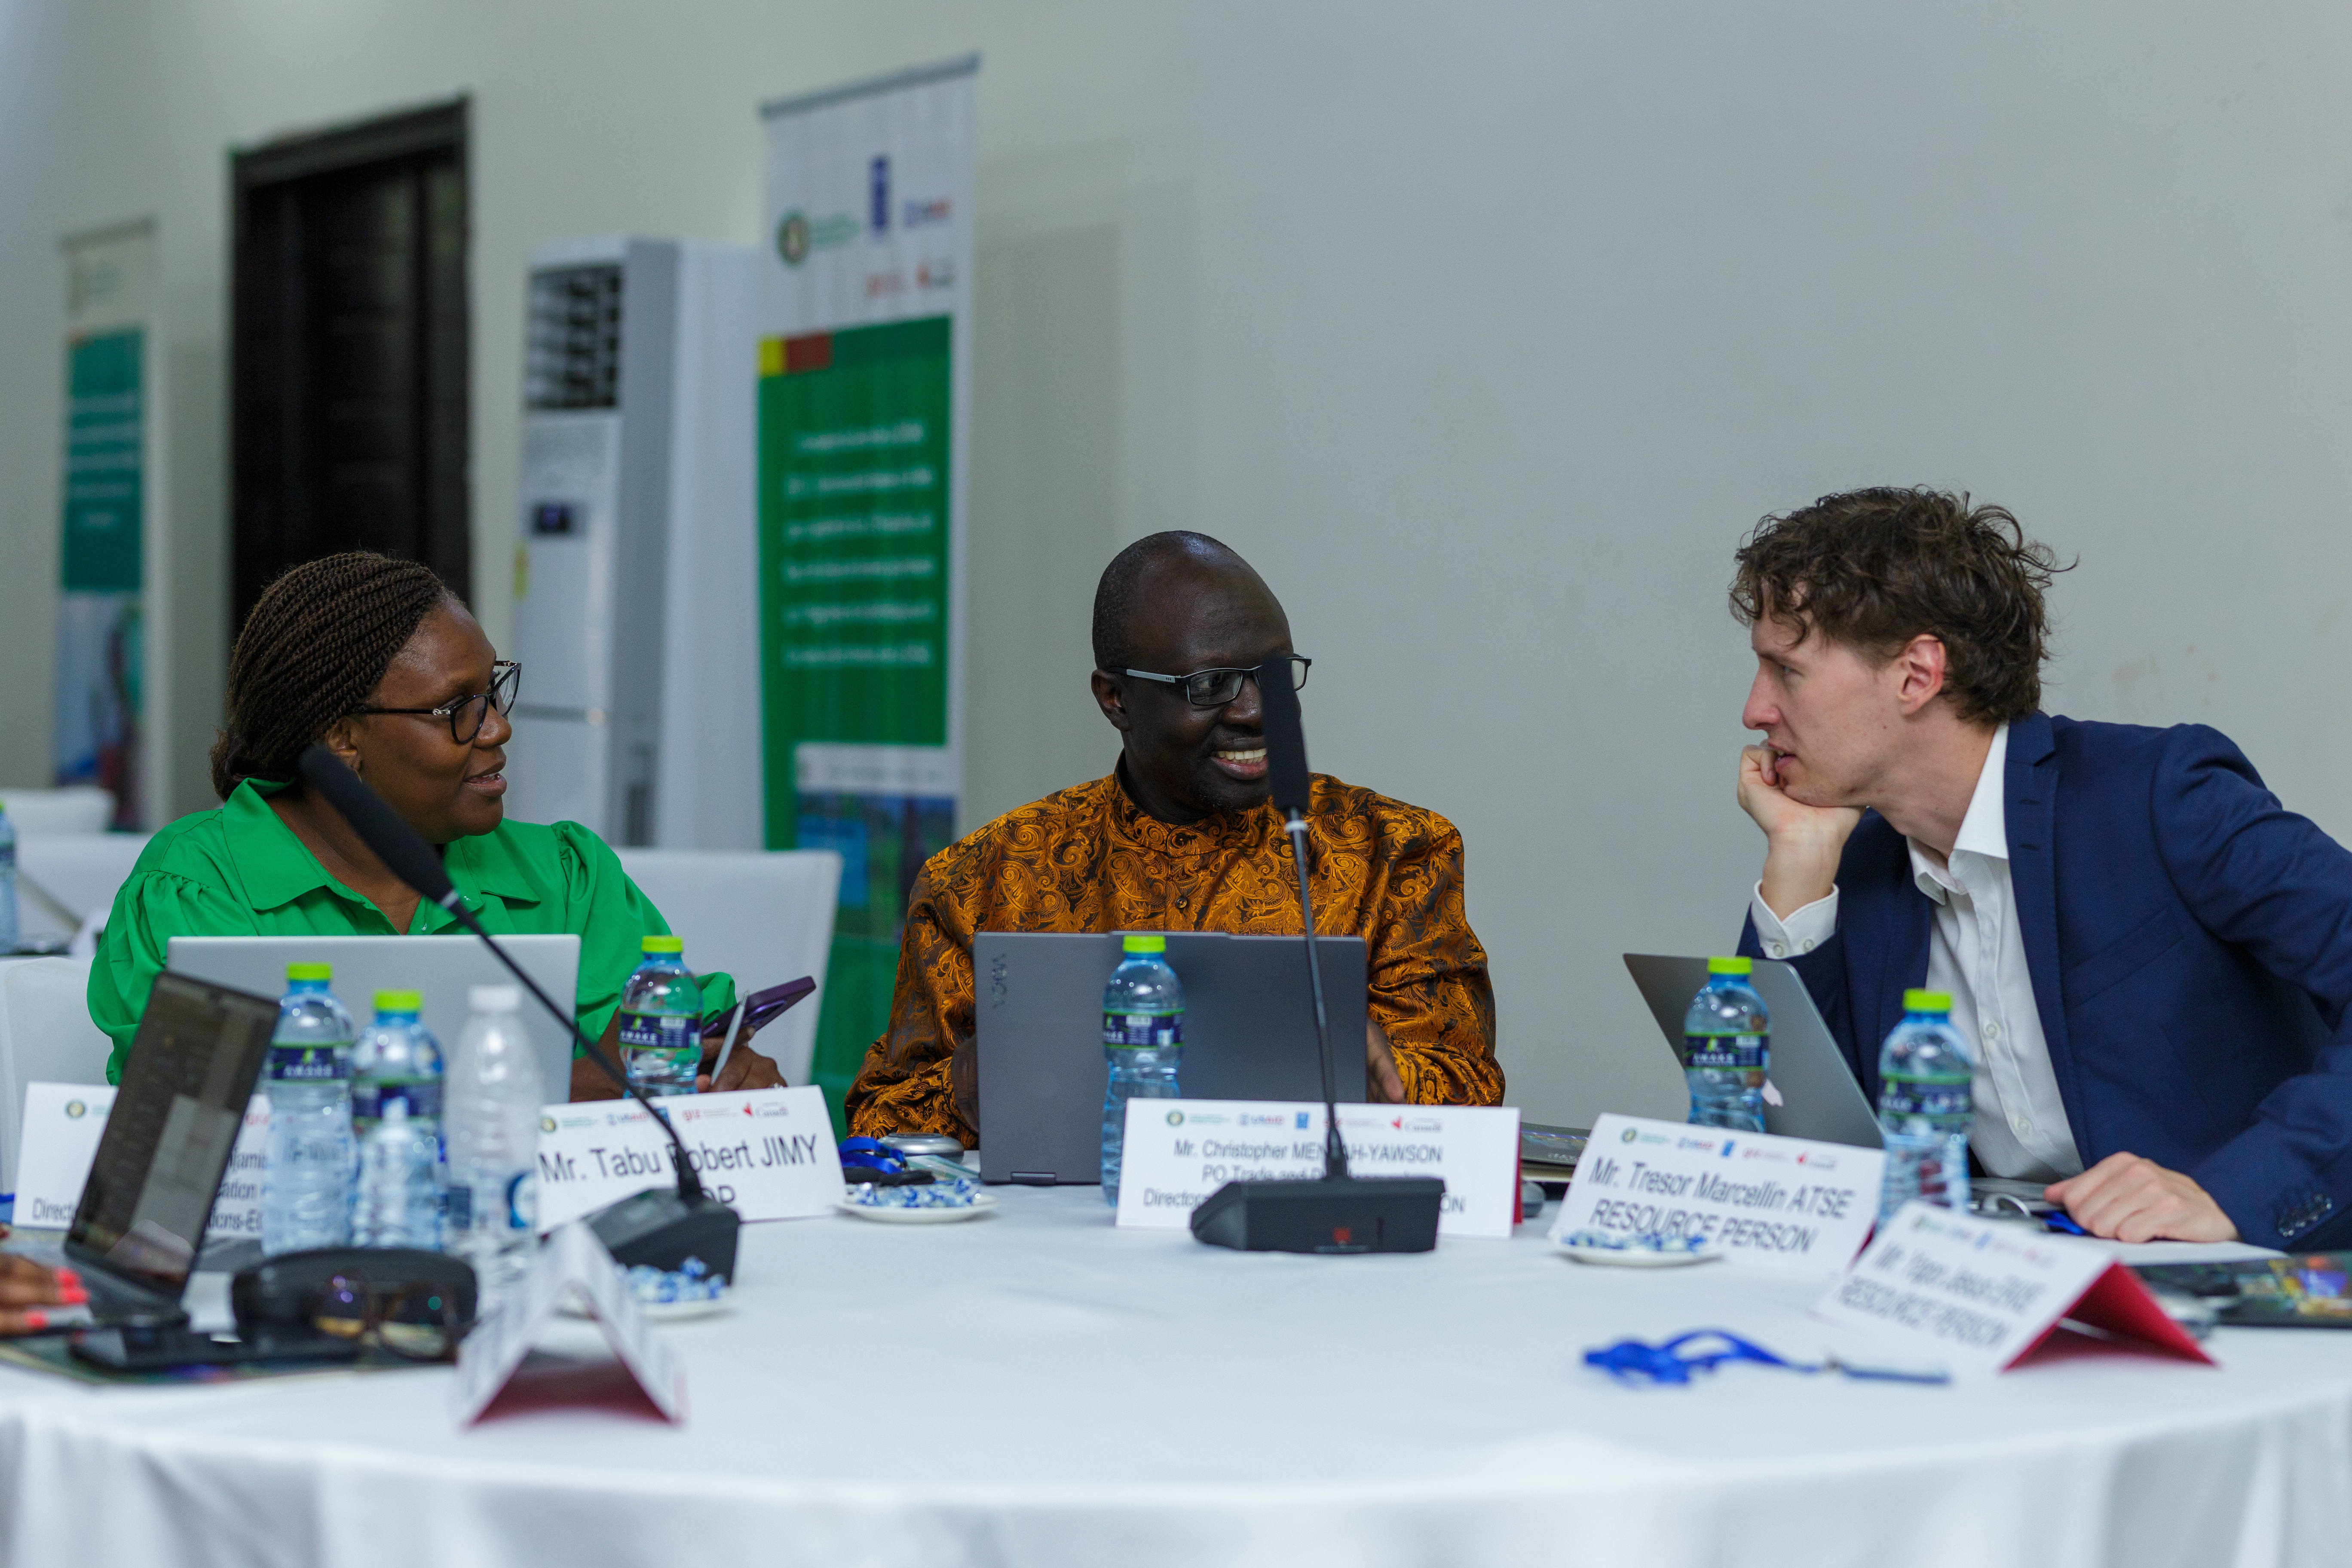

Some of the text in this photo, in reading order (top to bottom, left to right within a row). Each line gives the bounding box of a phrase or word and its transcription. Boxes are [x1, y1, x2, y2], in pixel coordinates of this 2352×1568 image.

[1693, 1052, 1734, 1064] AWAKE
[539, 1152, 586, 1182] Mr.
[590, 1145, 661, 1178] Tabu
[761, 1133, 816, 1166] JIMY
[1174, 1139, 1442, 1164] Mr. Christopher MENAH-YAWSON
[1202, 1164, 1227, 1182] PO
[1589, 1156, 1856, 1219] Mr. Tresor Marcellin ATSE
[32, 1197, 75, 1221] Direct
[1589, 1197, 1819, 1253] RESOURCE PERSON
